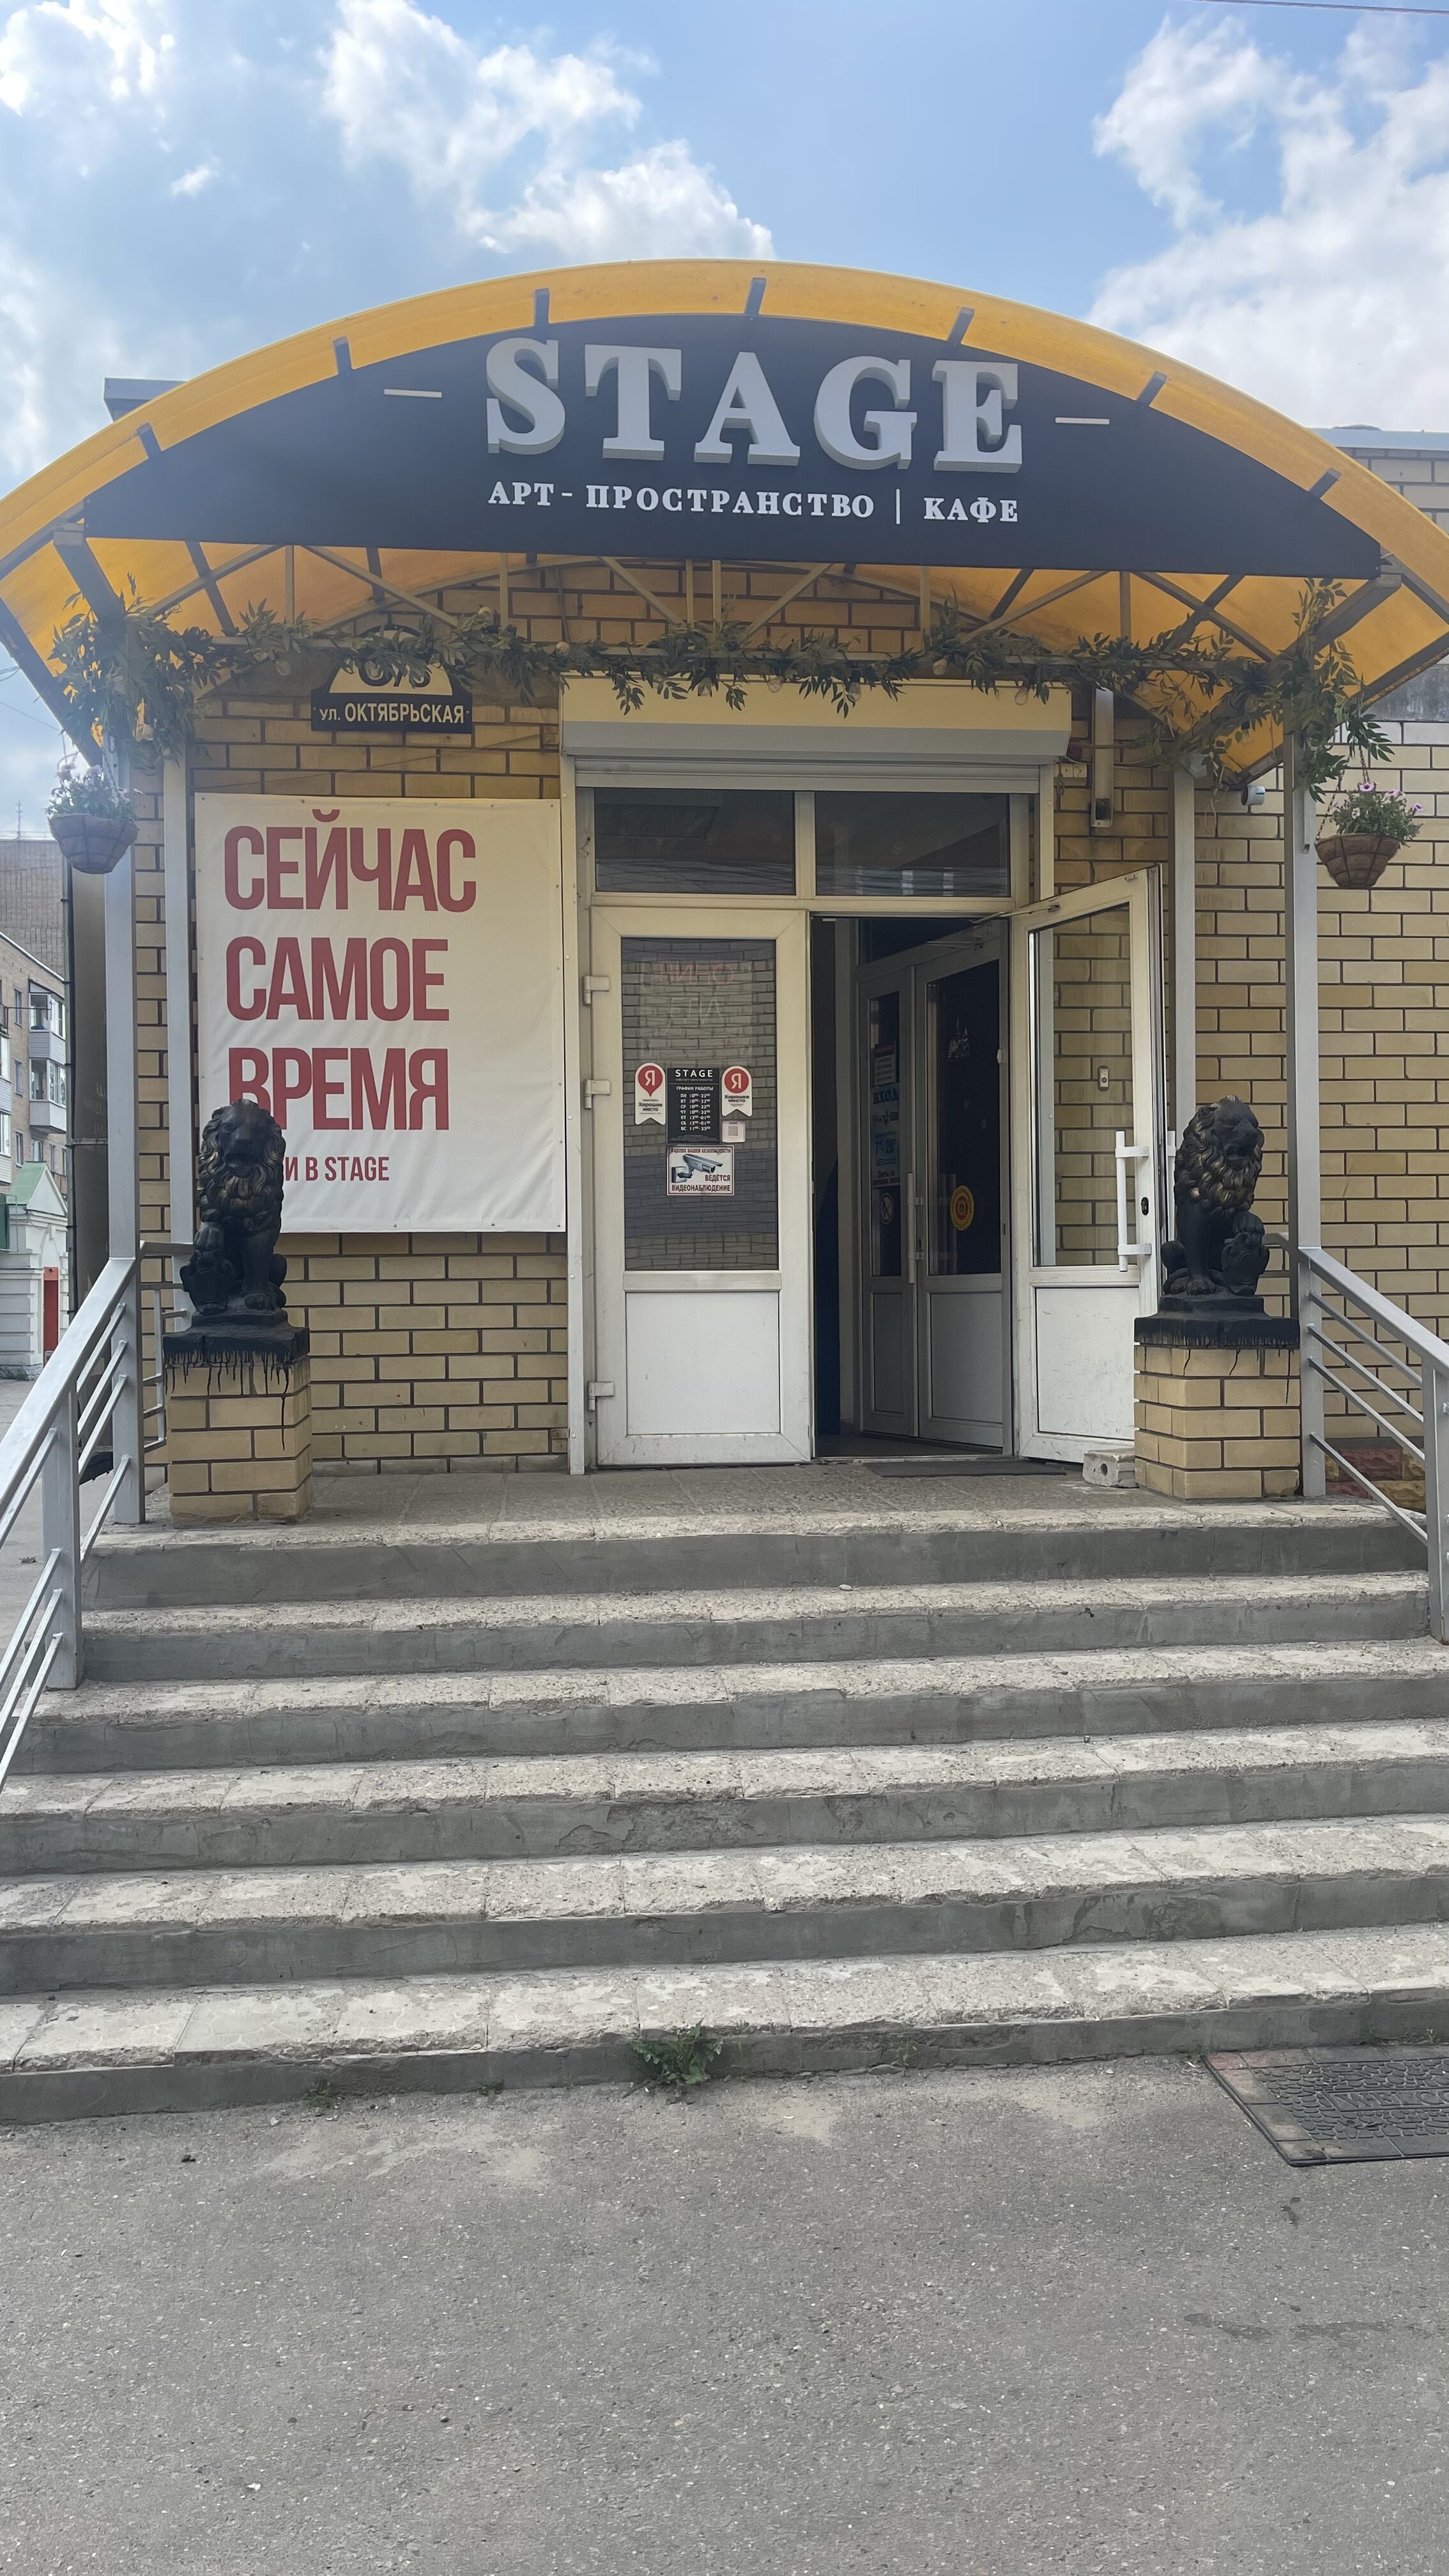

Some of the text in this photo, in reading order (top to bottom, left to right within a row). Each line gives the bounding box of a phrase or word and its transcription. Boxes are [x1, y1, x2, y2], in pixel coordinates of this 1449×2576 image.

[486, 337, 1023, 473] STAGE
[585, 483, 875, 518] ПРОСТРАНСТВО
[923, 496, 1018, 523] КАФЕ
[344, 702, 464, 724] ОКТЯБРЬСКАЯ
[224, 809, 477, 912] СЕЙЧАС
[226, 935, 450, 1022] САМОЕ
[644, 1070, 656, 1086] Я
[675, 1069, 714, 1078] STAGE
[731, 1073, 742, 1089] Я
[228, 1047, 450, 1131] ВРЕМЯ
[305, 1156, 318, 1181] В
[325, 1156, 390, 1181] STAGE
[671, 1184, 730, 1193] ВИДЕОНАБЛЮДЕНИЕ
